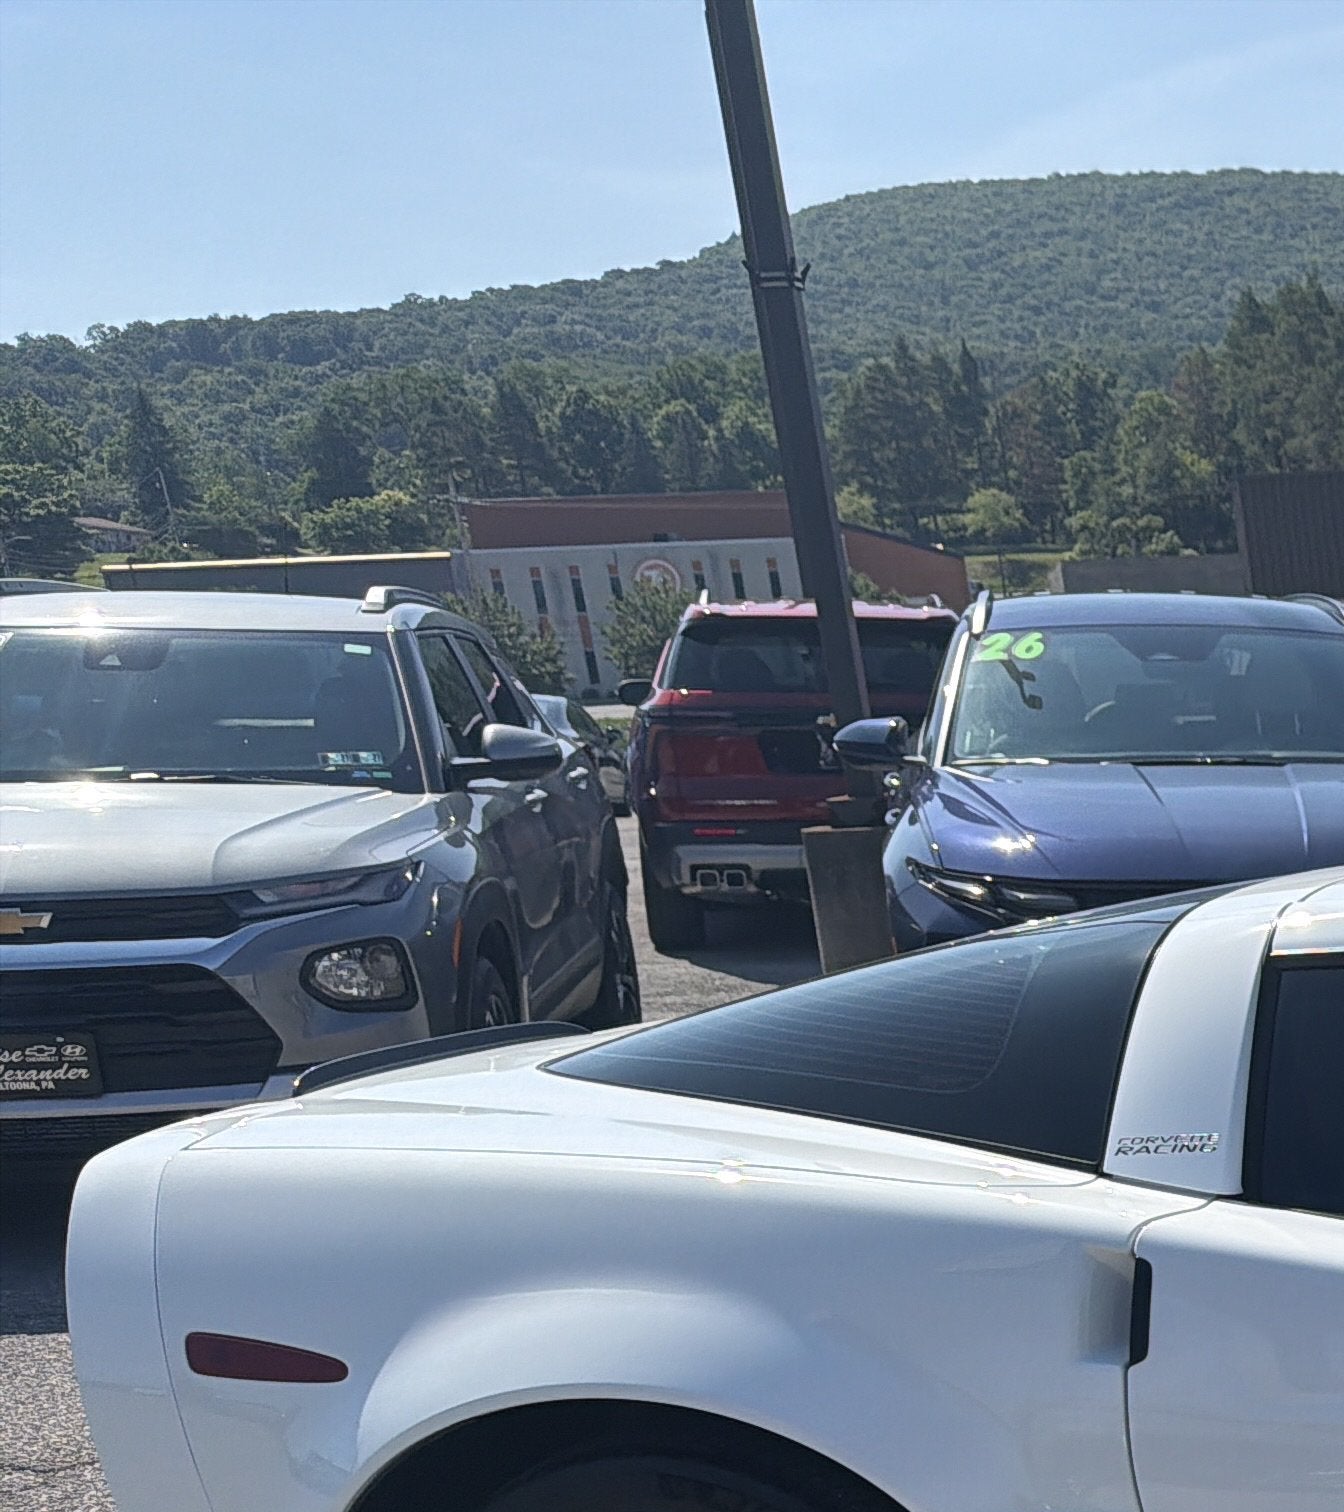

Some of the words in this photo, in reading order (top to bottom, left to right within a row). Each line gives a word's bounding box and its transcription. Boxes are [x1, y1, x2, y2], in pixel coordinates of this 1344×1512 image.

[978, 632, 1045, 661] 26
[0, 1081, 41, 1091] LTOONA,
[41, 1081, 56, 1090] PA
[1114, 1143, 1218, 1156] RACING
